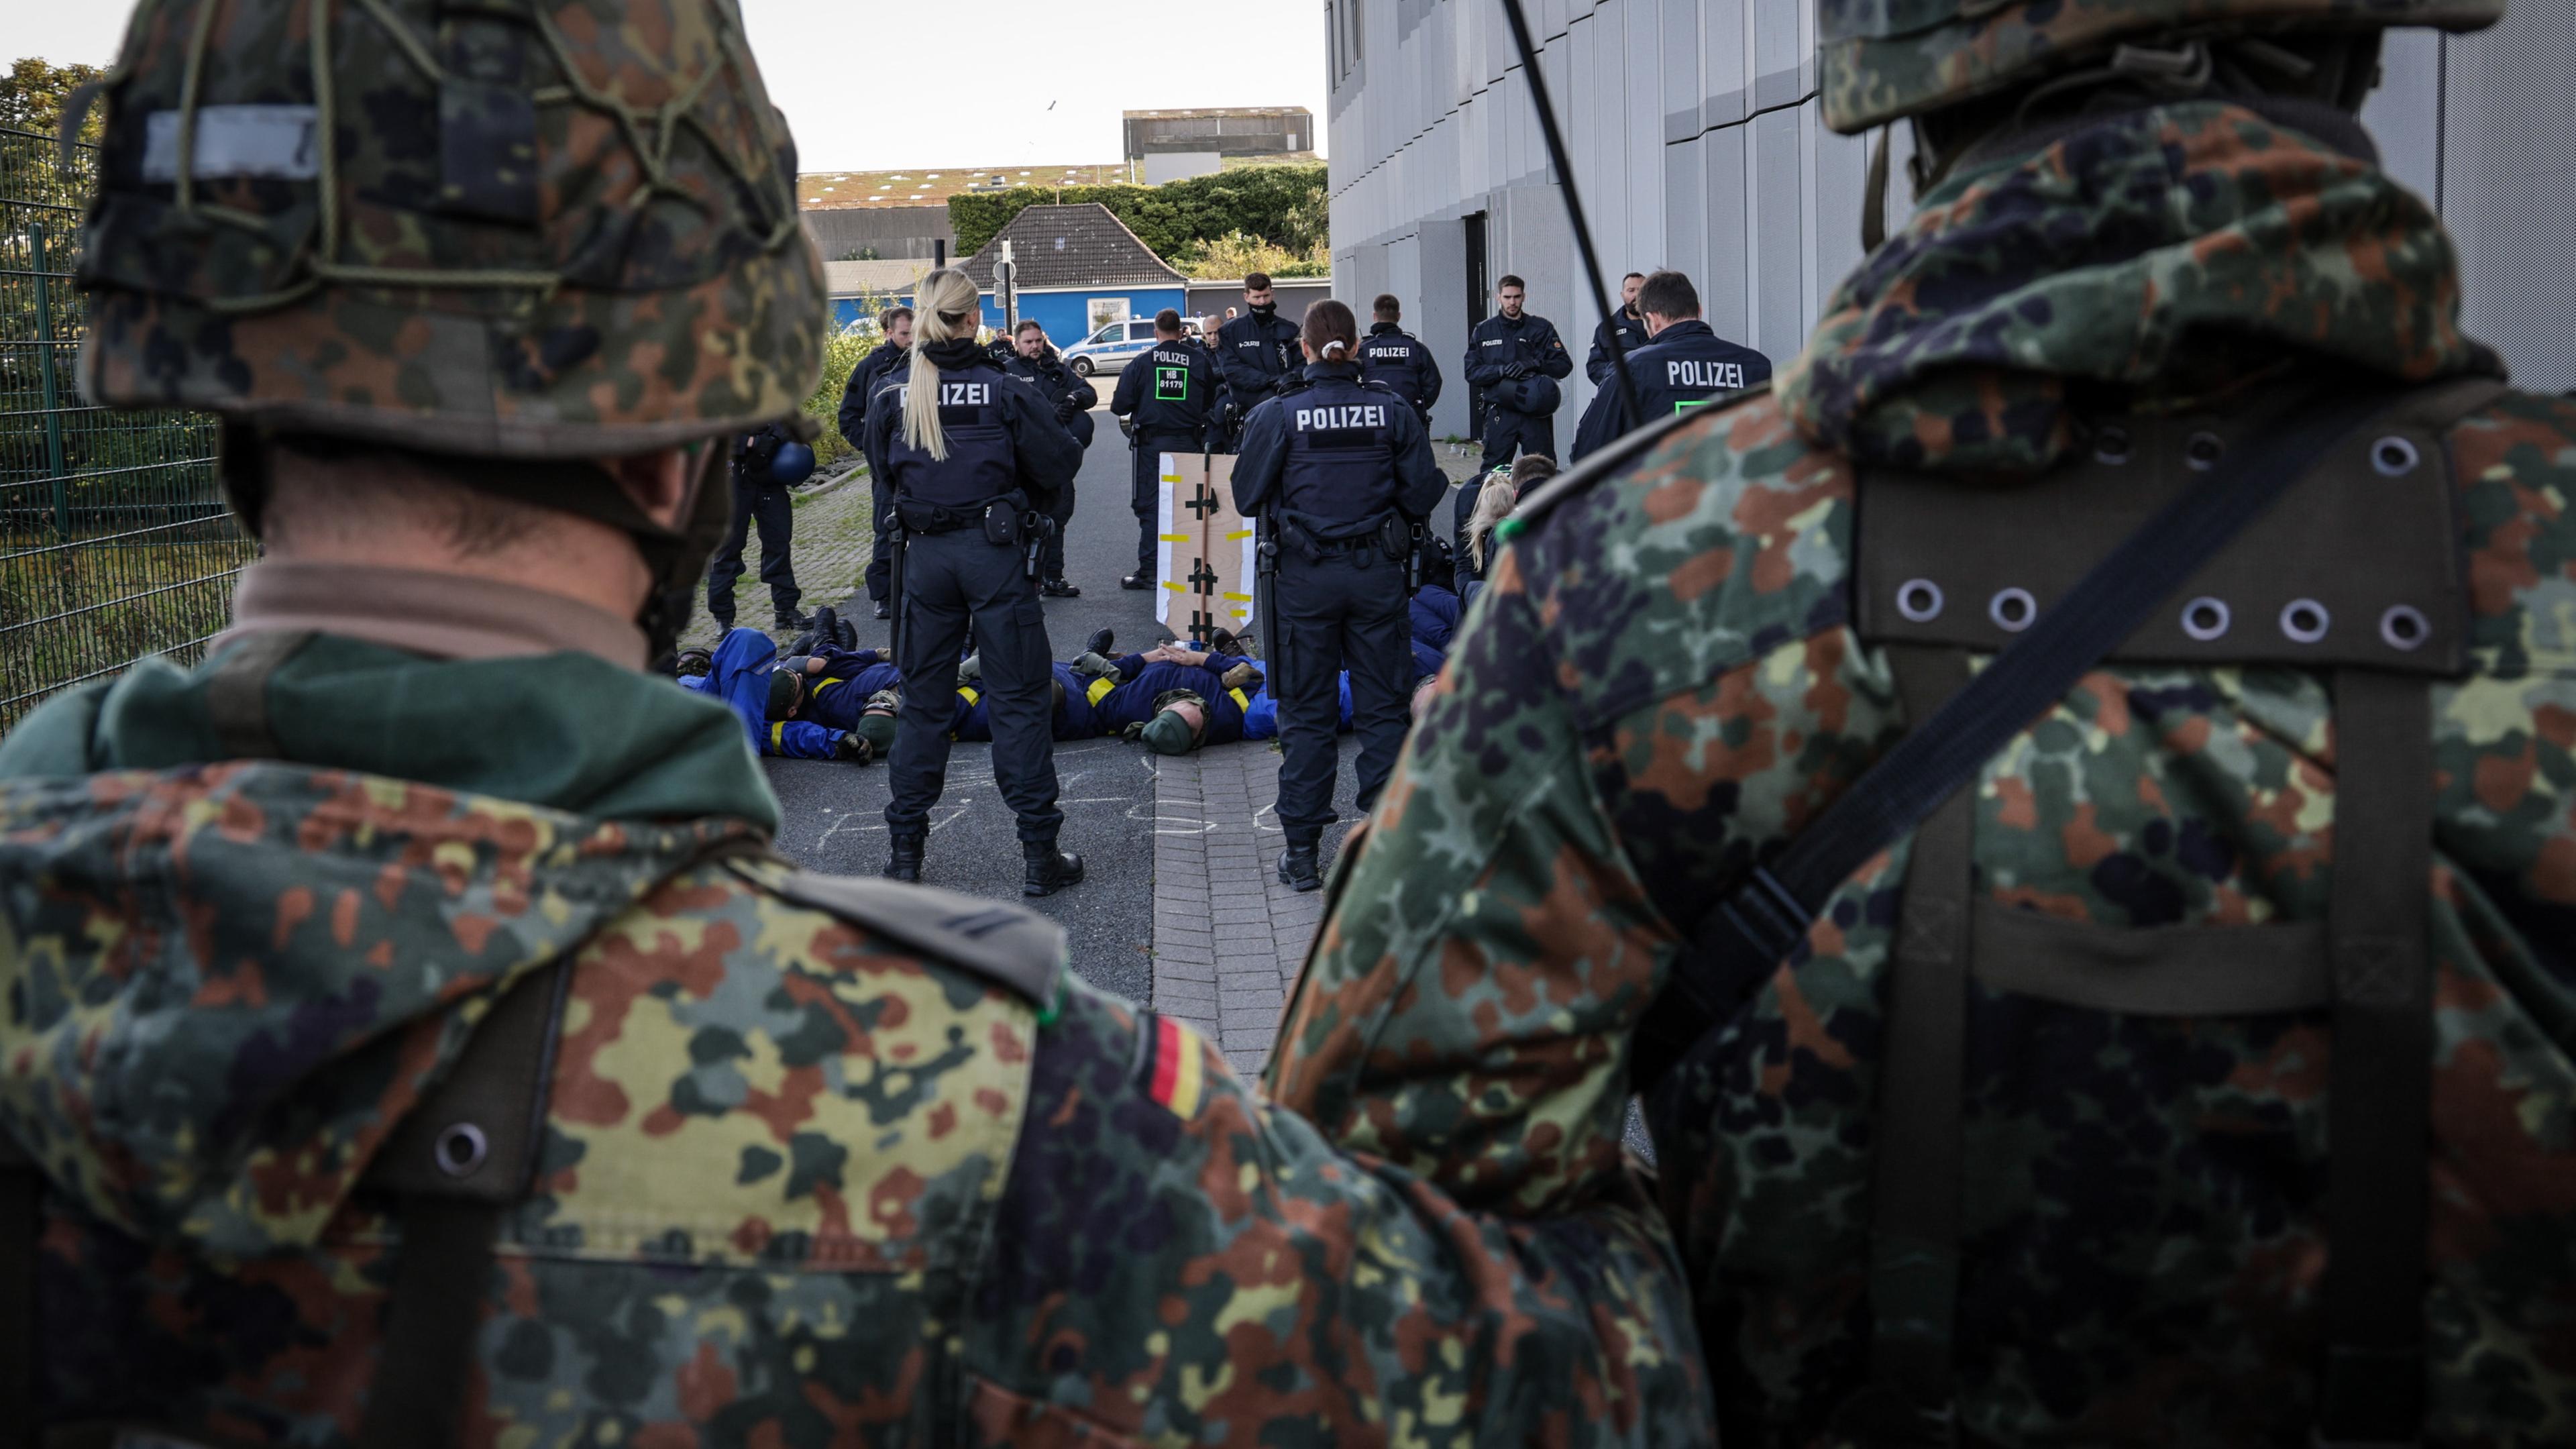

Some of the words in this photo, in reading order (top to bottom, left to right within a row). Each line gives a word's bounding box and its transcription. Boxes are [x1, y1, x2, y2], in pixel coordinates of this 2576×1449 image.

[1153, 351, 1189, 366] POLIZEI
[1369, 347, 1409, 358] POLIZEI
[1166, 370, 1177, 379] HB
[1668, 360, 1744, 388] POLIZEI
[1160, 380, 1183, 388] 81179
[900, 383, 989, 407] PIZEI
[1296, 405, 1386, 431] POLIZEI
